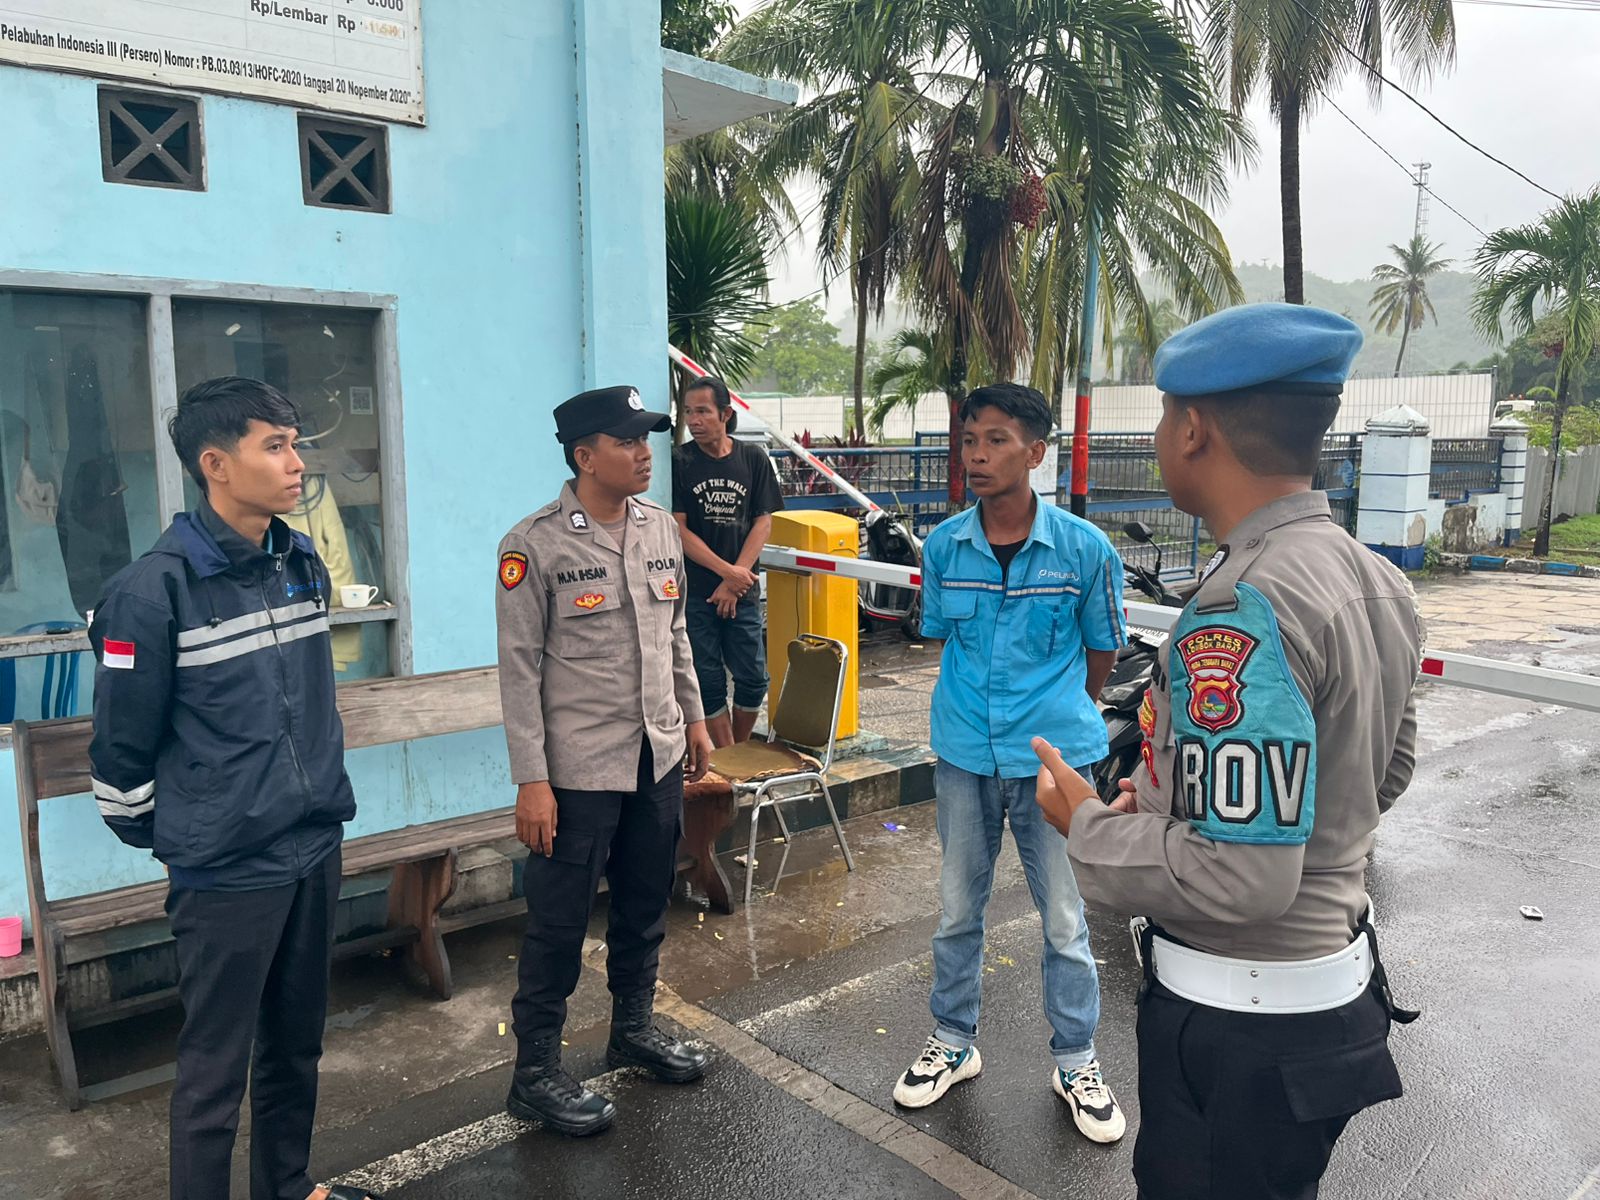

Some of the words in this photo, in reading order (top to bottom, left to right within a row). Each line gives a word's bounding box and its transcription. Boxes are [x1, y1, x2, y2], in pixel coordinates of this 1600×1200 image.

[250, 0, 328, 25] Rp/Lembar
[337, 14, 356, 33] Rp
[0, 23, 55, 48] Pelabuhan
[57, 32, 105, 56] Indonesia
[107, 40, 118, 58] III
[119, 42, 163, 68] (Persero)
[164, 50, 194, 69] Nomor
[303, 73, 334, 94] tanggal
[336, 78, 346, 94] 20
[348, 80, 388, 100] Nopember
[692, 481, 708, 495] OFF
[708, 478, 726, 487] THE
[727, 479, 748, 497] WALL
[704, 491, 737, 504] VANS
[704, 501, 737, 516] Original
[579, 566, 608, 582] IHSAN
[1187, 633, 1242, 648] POLRES
[1215, 641, 1242, 654] BARAT
